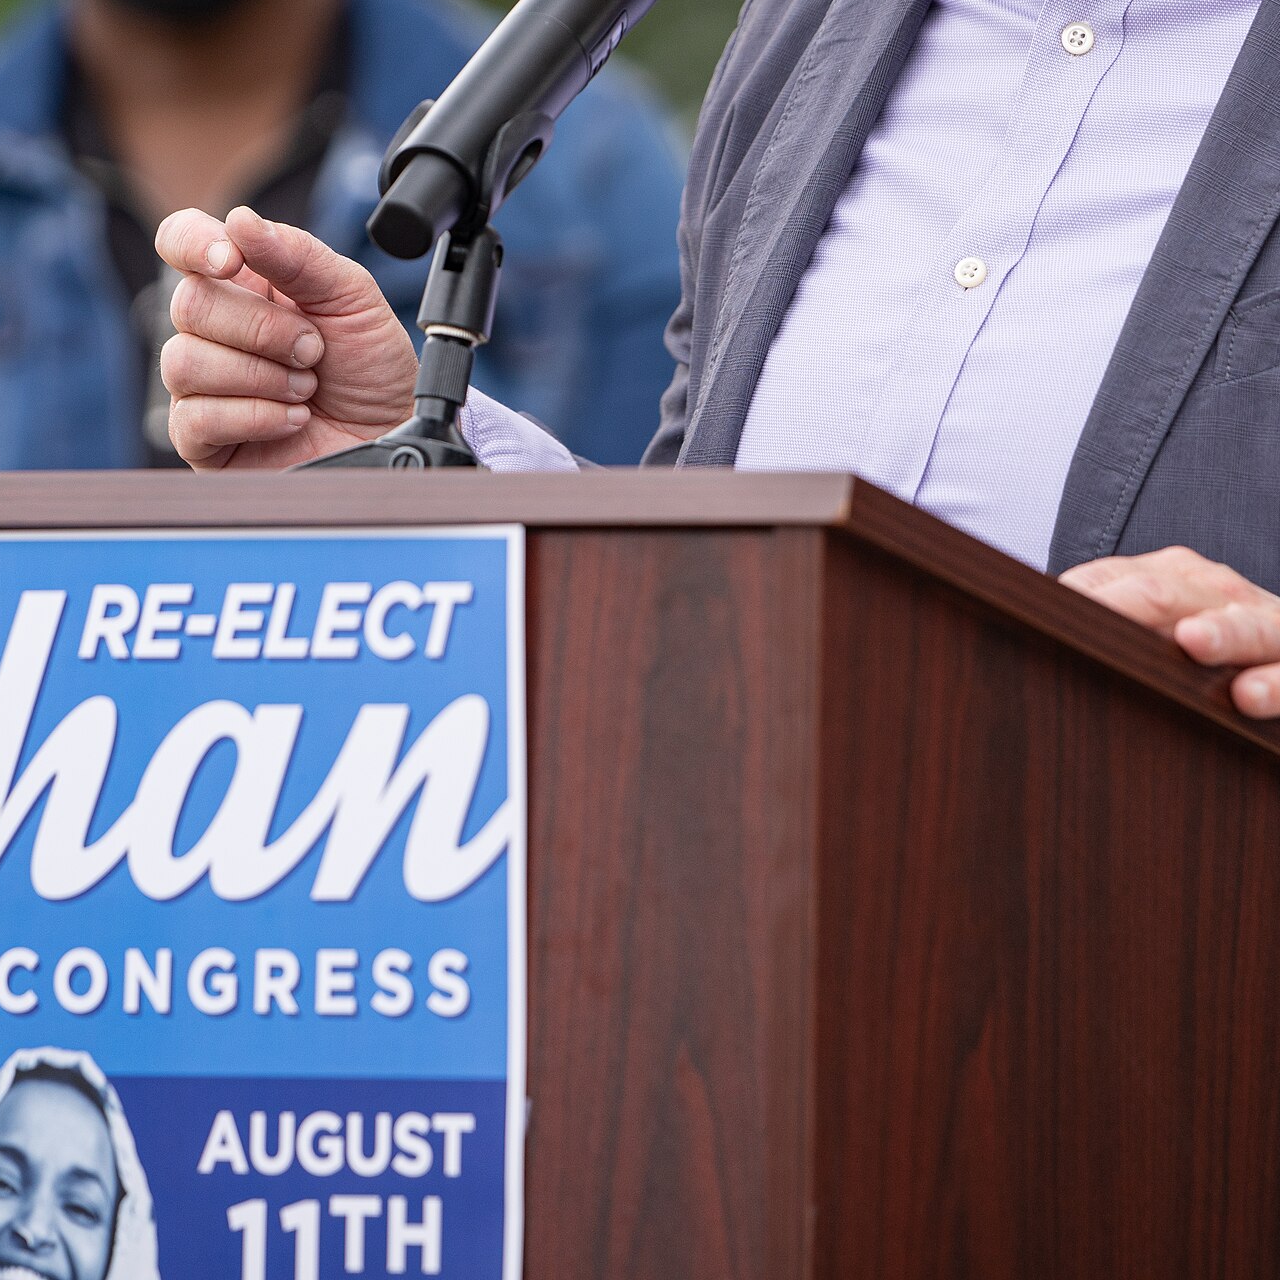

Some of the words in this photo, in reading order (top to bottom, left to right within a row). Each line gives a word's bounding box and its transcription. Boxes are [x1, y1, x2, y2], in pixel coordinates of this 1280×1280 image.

[78, 582, 474, 660] RE-ELECT
[197, 1110, 476, 1178] AUGUST
[227, 1195, 442, 1280] 11TH
